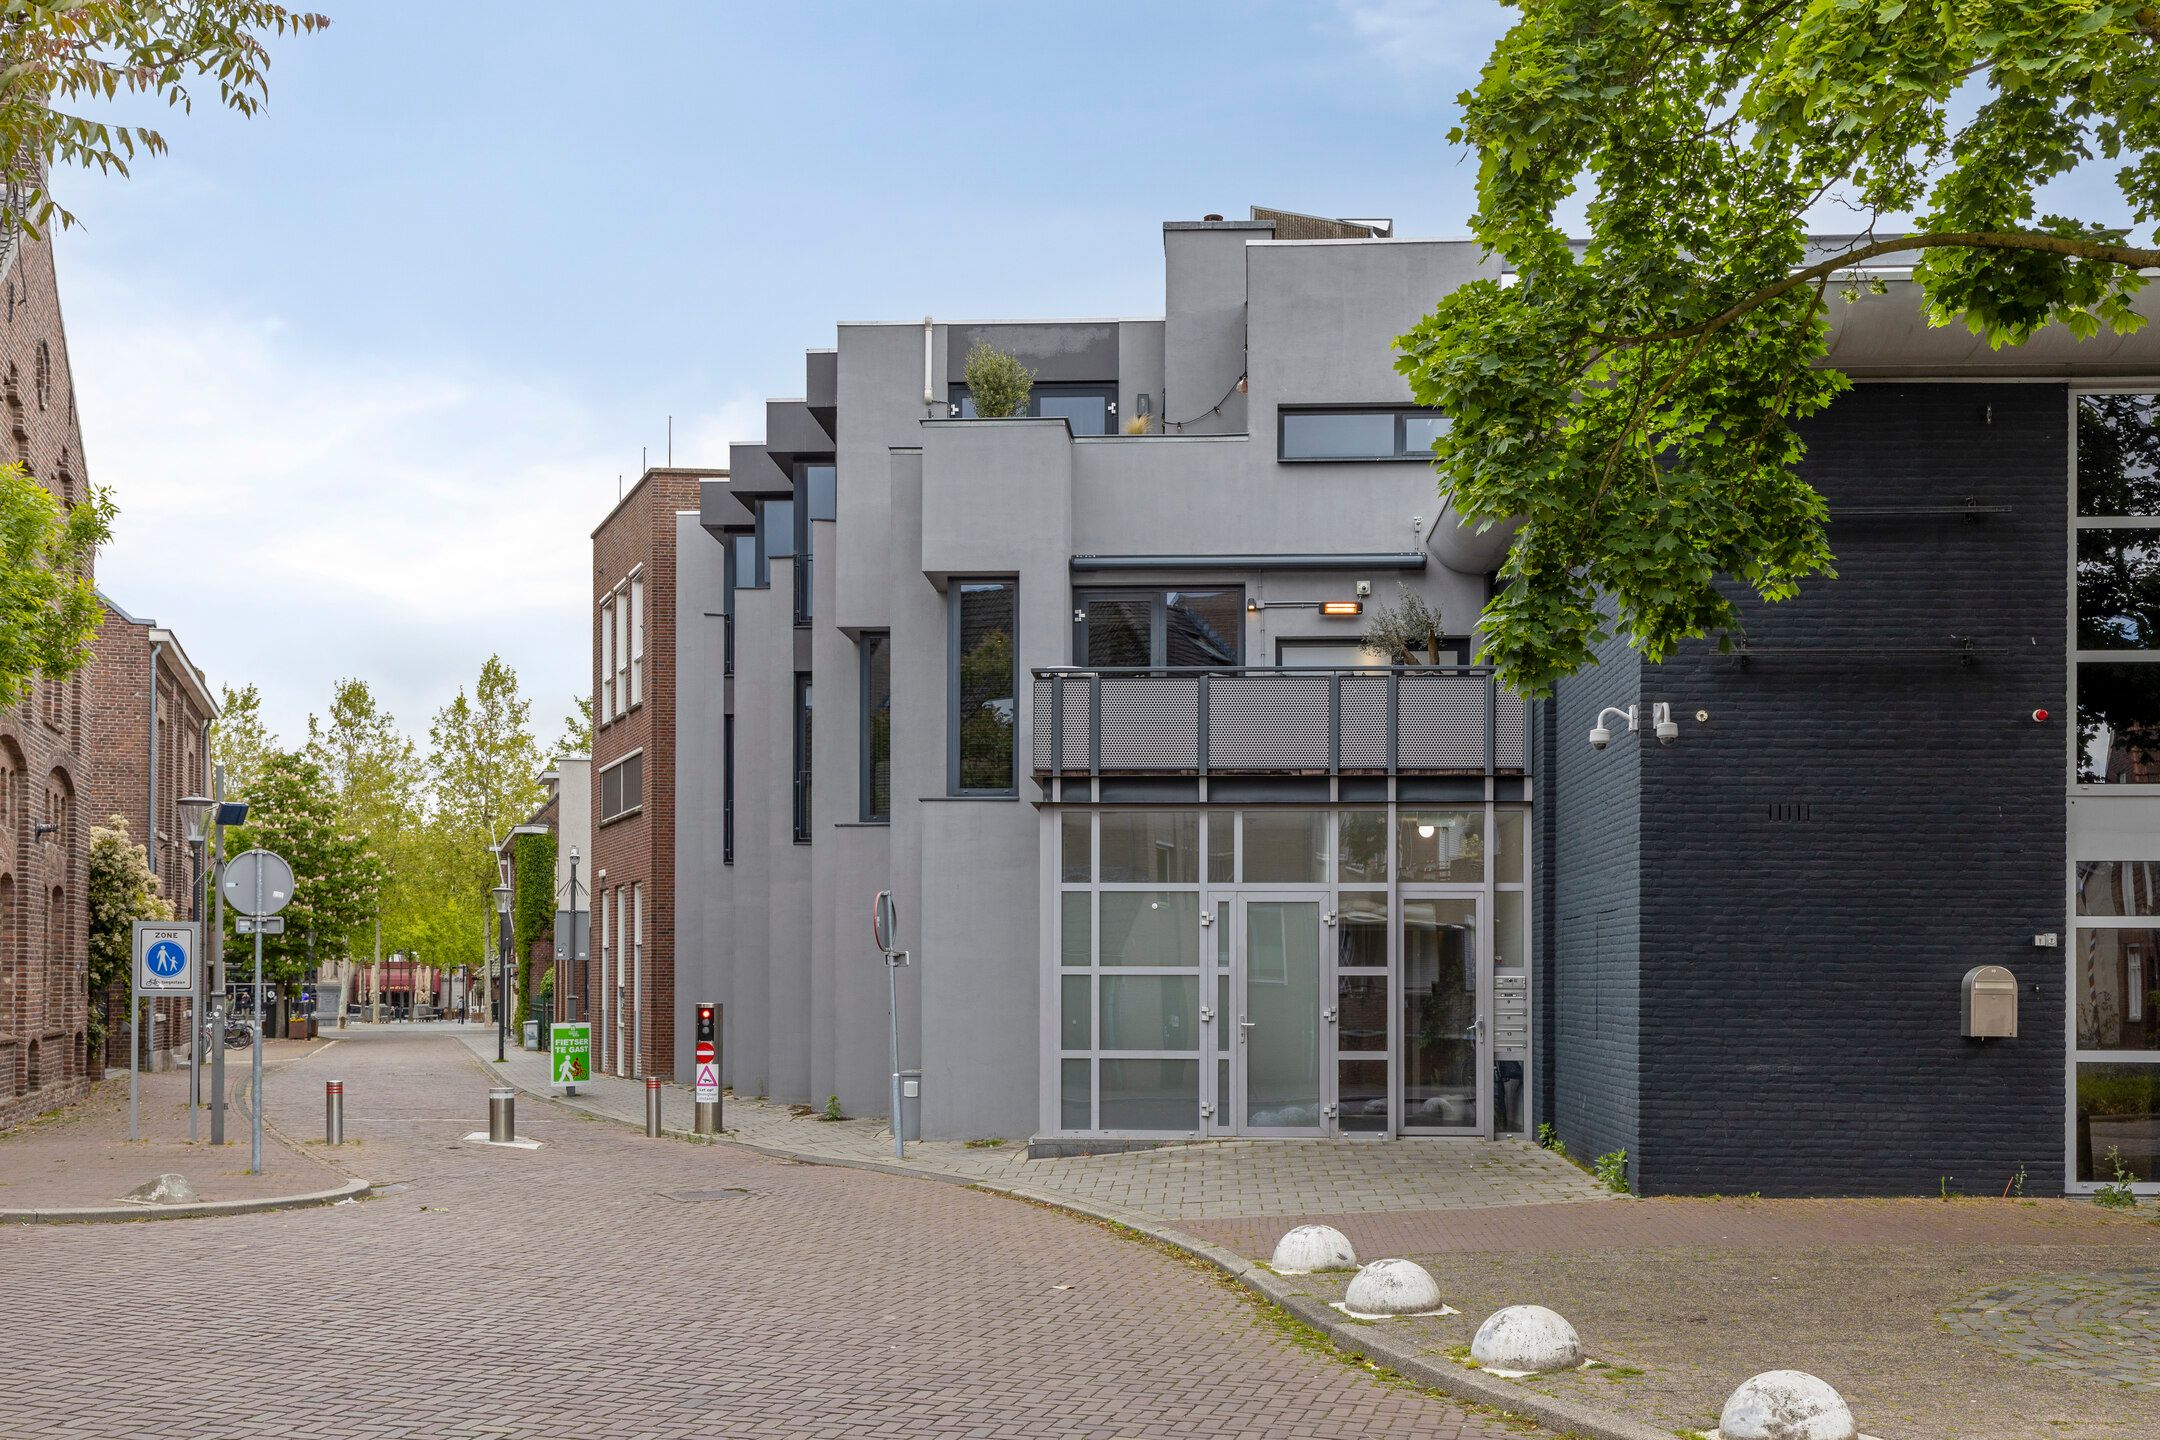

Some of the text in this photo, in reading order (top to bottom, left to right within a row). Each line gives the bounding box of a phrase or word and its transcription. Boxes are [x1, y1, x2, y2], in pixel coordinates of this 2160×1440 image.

[555, 1038, 589, 1046] FIETSER
[555, 1045, 589, 1054] TE GAST
